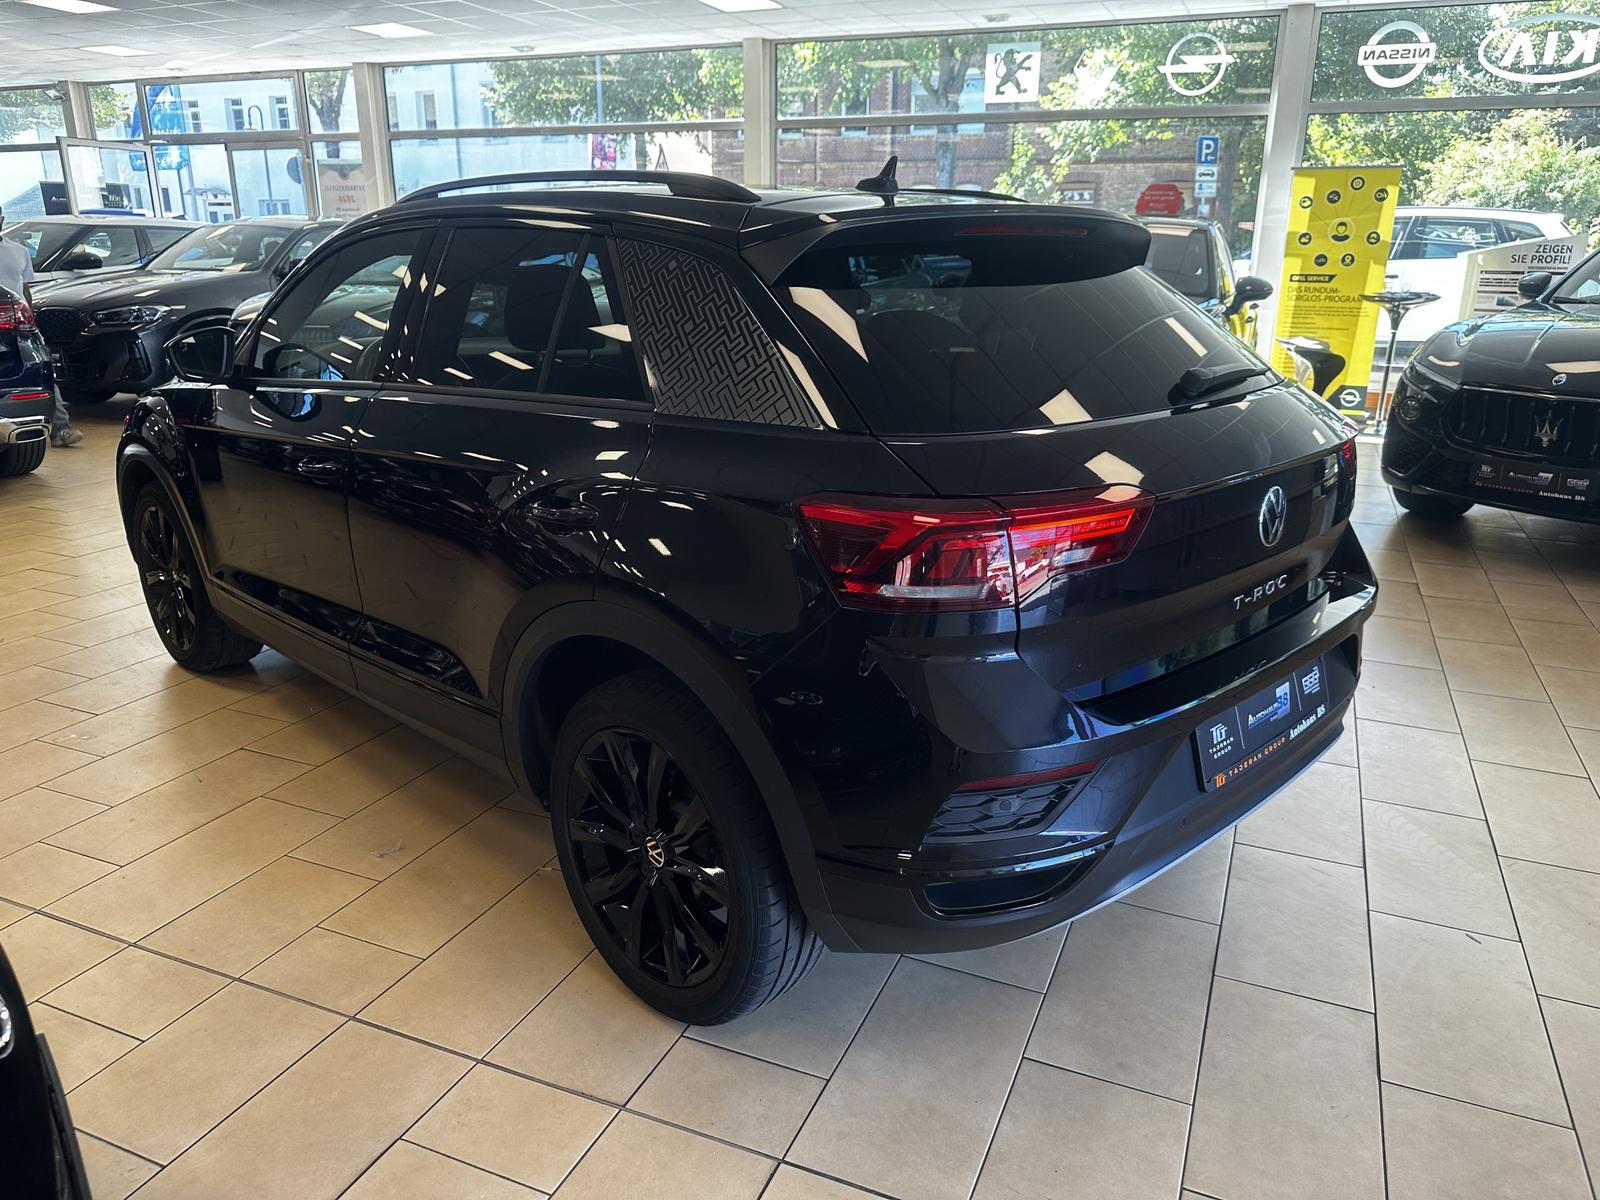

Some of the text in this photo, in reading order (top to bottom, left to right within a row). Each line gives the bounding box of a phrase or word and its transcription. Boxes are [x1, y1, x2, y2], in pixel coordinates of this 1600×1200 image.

[1201, 139, 1215, 162] P
[1510, 254, 1572, 265] SIE PROFIL!
[1535, 244, 1574, 254] ZEIGEN
[1234, 574, 1288, 610] T-ROC
[1228, 752, 1262, 777] TAJERAN
[1264, 737, 1286, 755] GROUP
[1289, 713, 1317, 740] Autohaus
